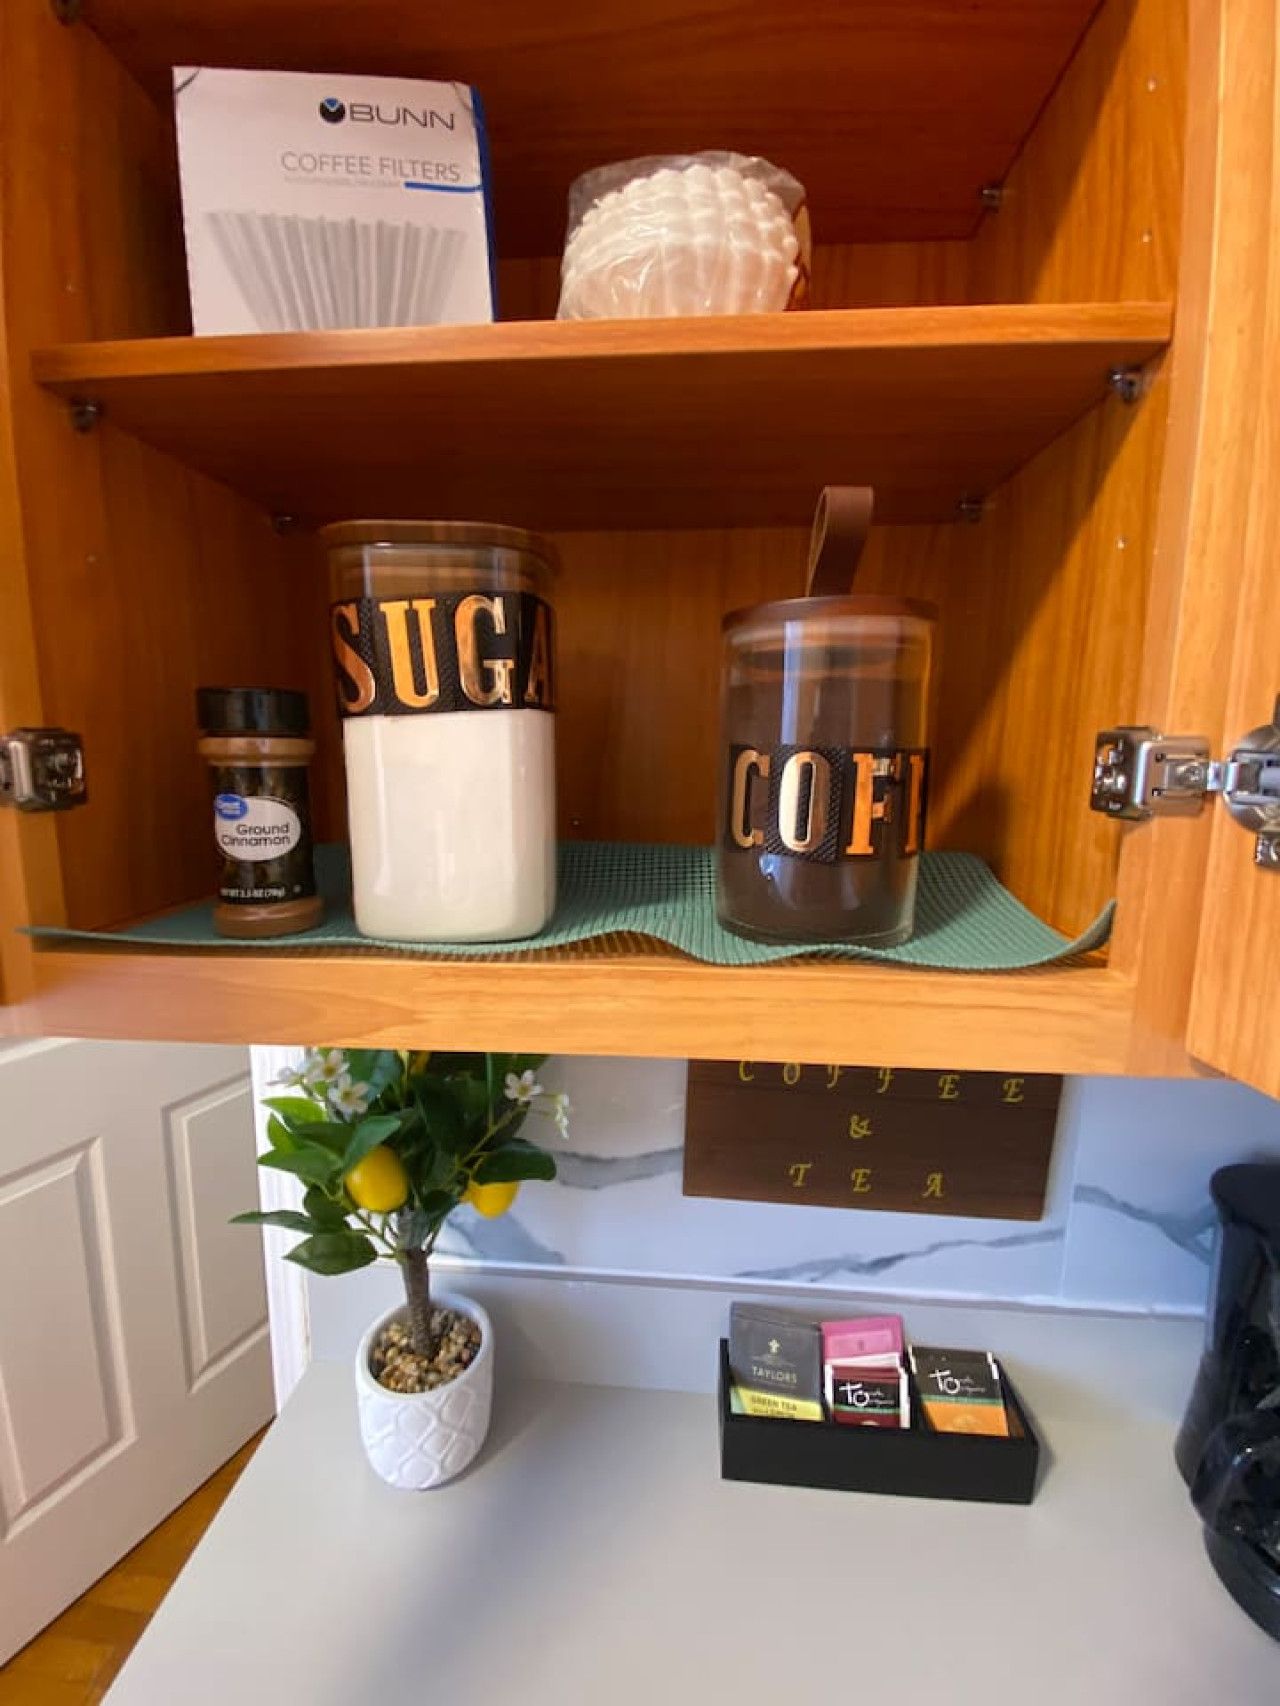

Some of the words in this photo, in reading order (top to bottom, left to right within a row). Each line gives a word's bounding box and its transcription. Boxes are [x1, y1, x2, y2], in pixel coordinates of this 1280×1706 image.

[350, 102, 455, 131] BUNN
[281, 150, 371, 175] COFFEE
[379, 157, 461, 183] FILTERS
[221, 834, 290, 847] Cinnamon
[236, 823, 290, 836] Ground
[848, 1114, 872, 1139] &
[752, 1365, 798, 1384] TAYLORS
